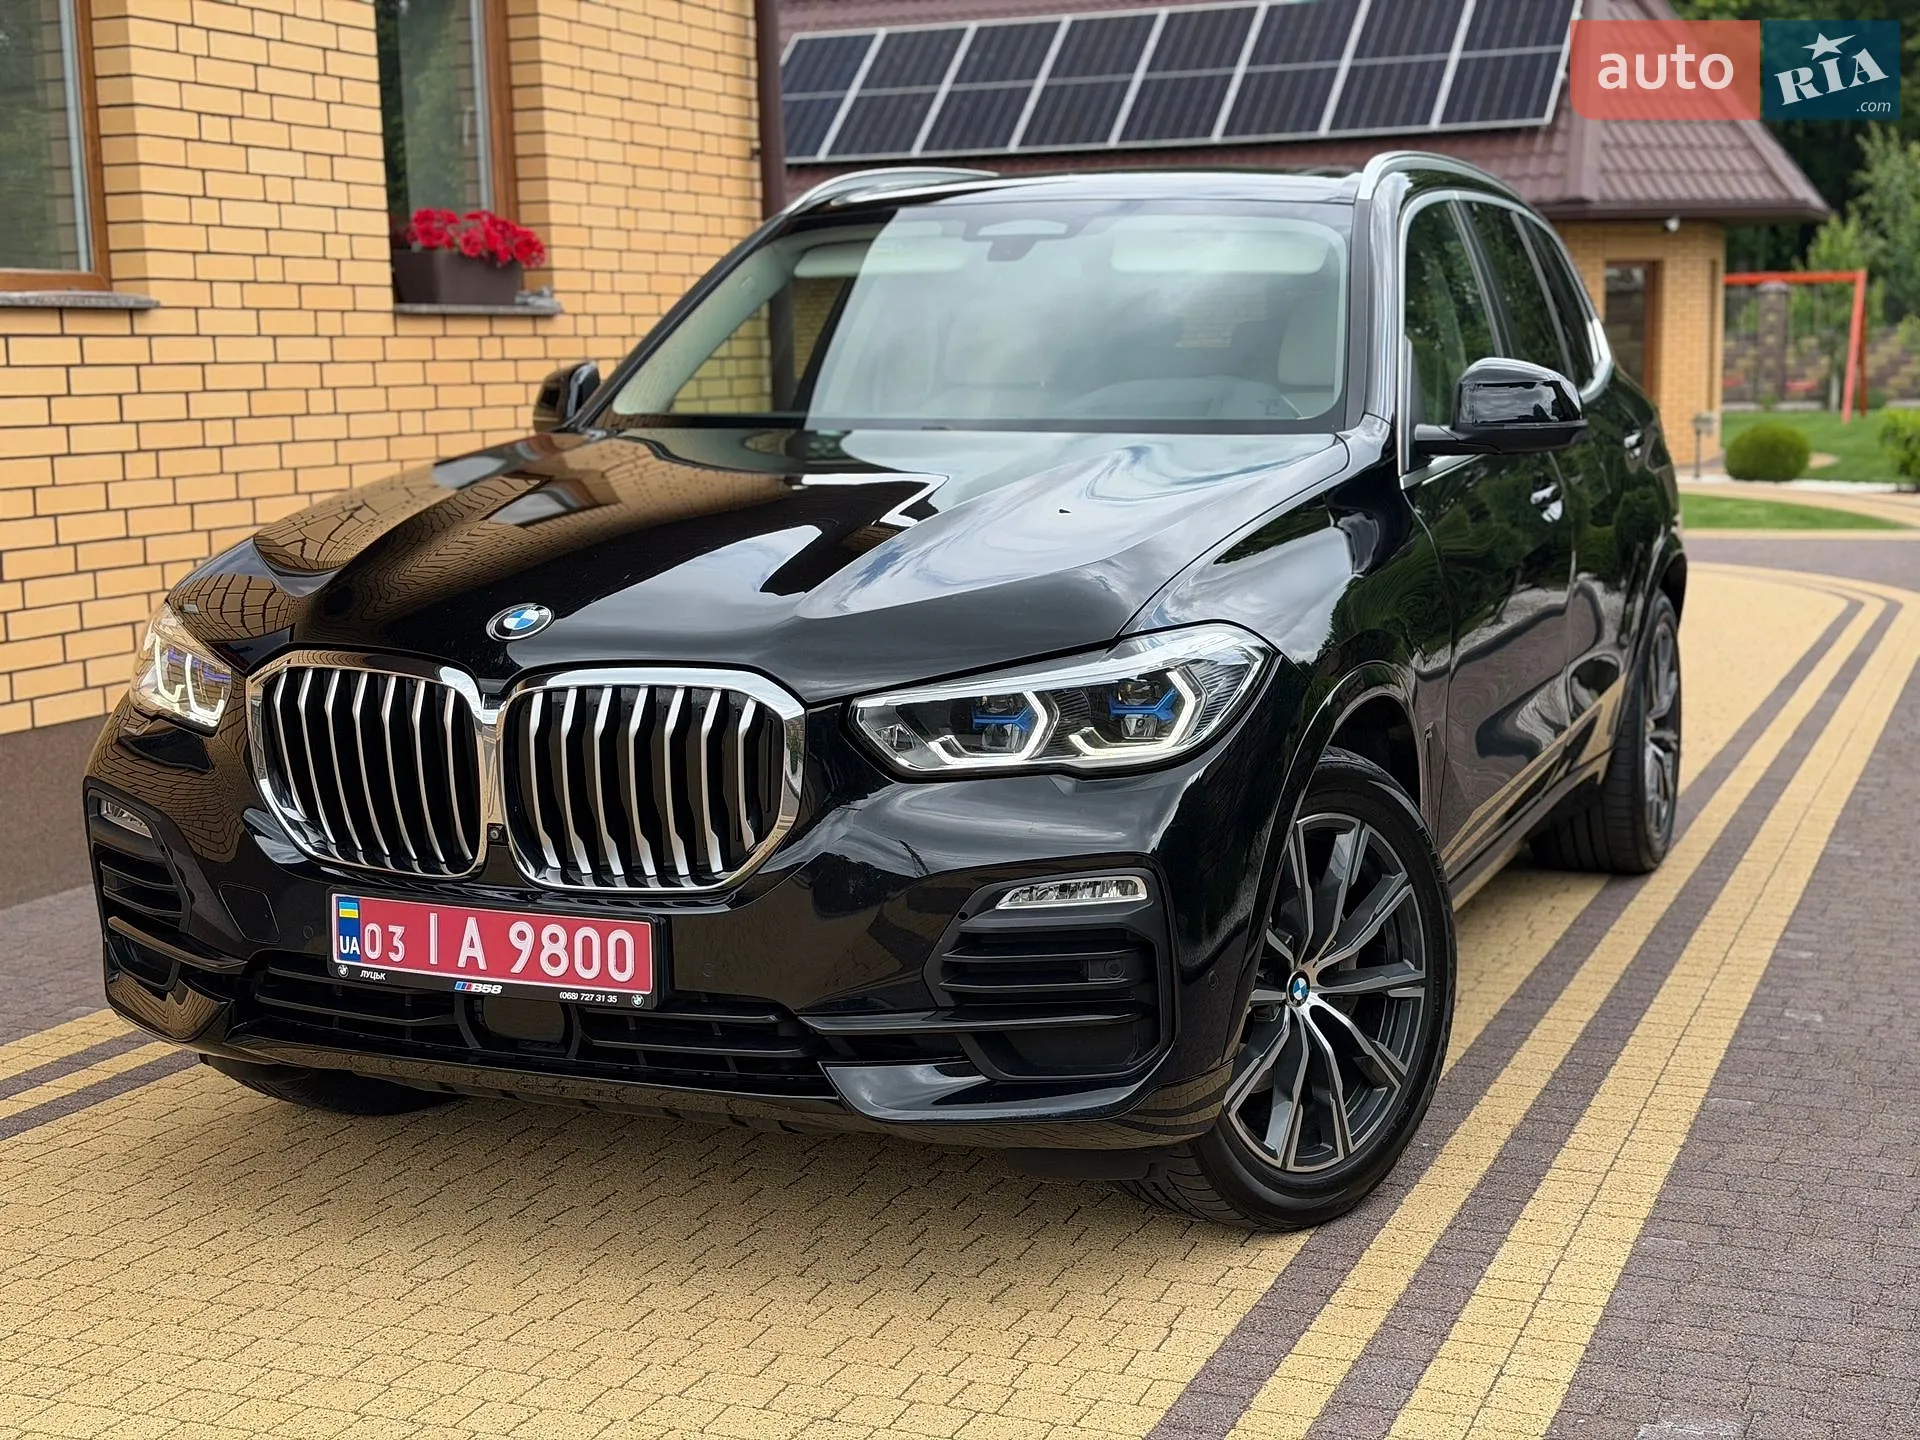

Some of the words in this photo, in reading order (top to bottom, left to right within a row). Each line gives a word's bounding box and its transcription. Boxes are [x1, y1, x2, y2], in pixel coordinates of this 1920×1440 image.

[339, 935, 361, 955] UA
[364, 923, 405, 962] 03
[508, 921, 635, 982] 9800
[580, 992, 595, 1001] 727
[595, 994, 605, 1002] 31
[607, 995, 618, 1003] 35
